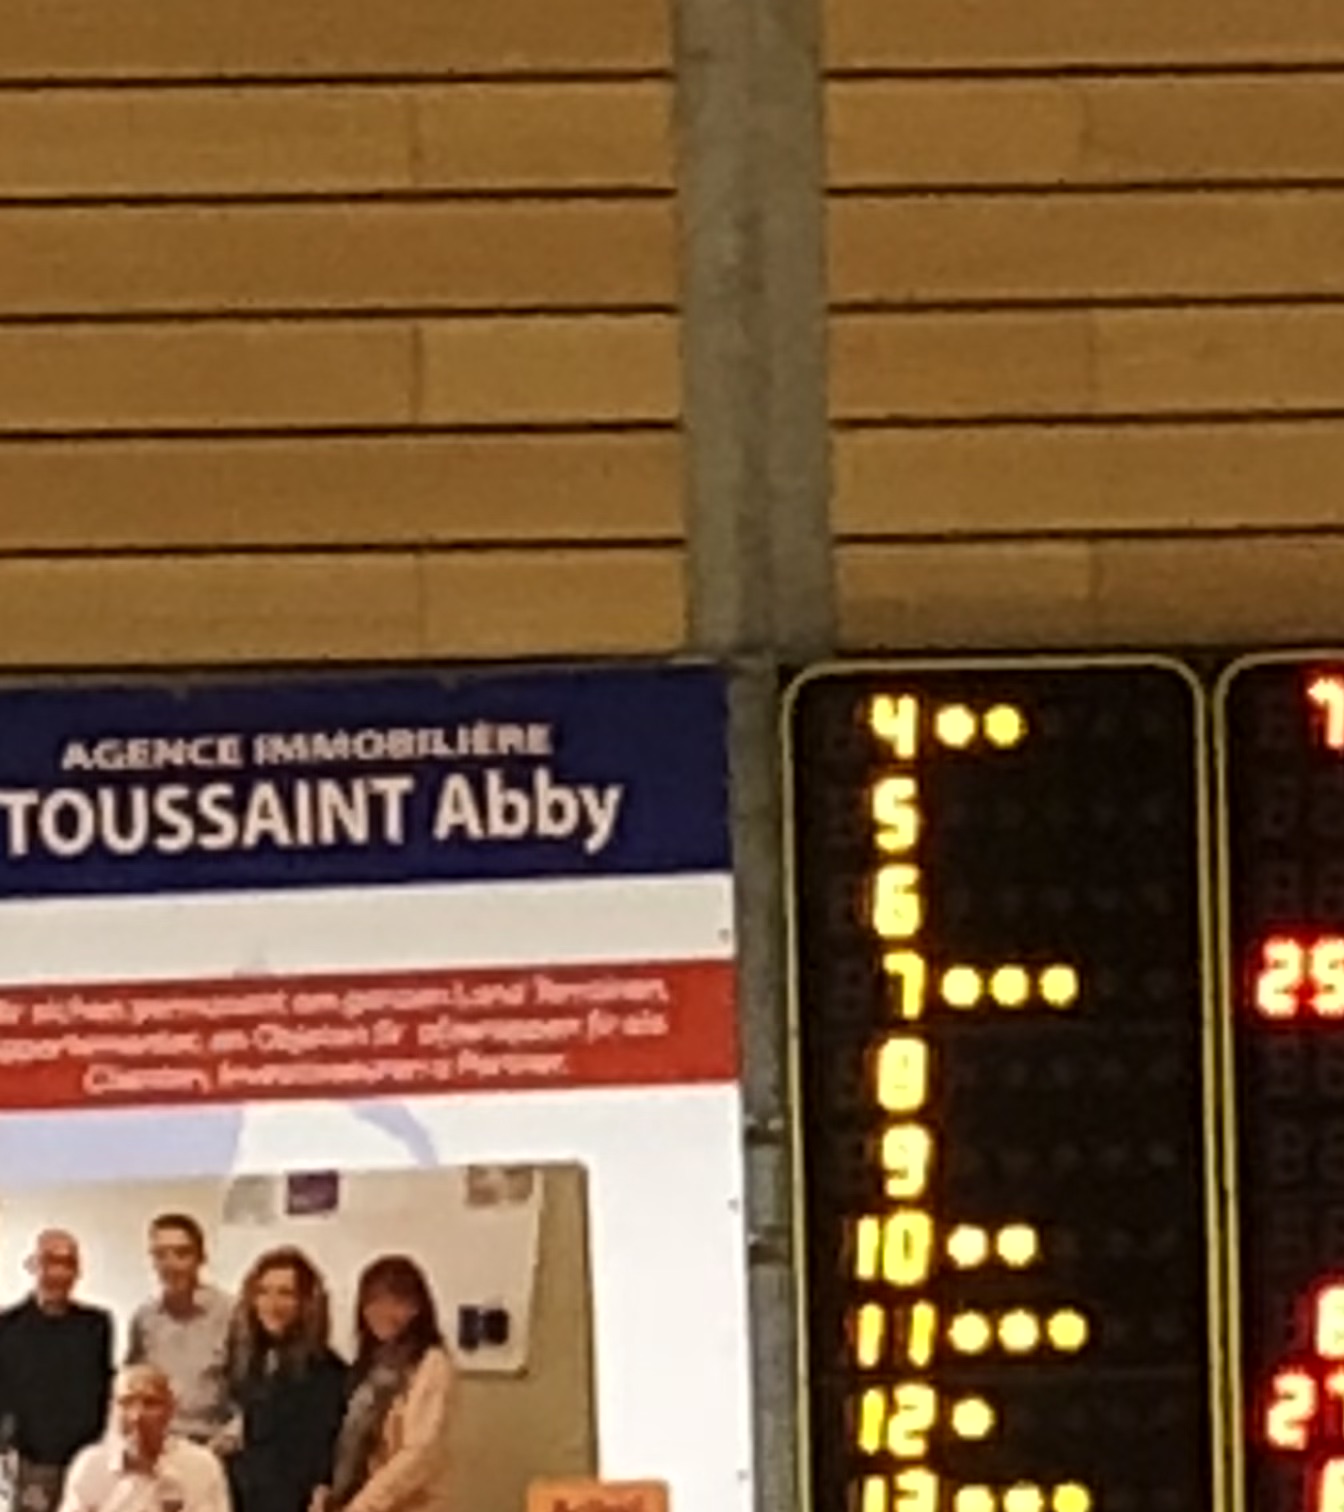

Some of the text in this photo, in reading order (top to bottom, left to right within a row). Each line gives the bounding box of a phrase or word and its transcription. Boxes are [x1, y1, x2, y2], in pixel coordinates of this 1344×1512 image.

[61, 721, 553, 771] AGENCE IMMOBILIÈRE
[872, 694, 918, 758] 4
[0, 770, 624, 857] TOUSSAINT Abby
[872, 777, 919, 853] 5
[873, 865, 921, 938] 6
[882, 950, 925, 1019] 7
[881, 1124, 931, 1196] 9
[855, 1209, 933, 1286] 10
[857, 1300, 936, 1368] 11
[857, 1382, 936, 1457] 12
